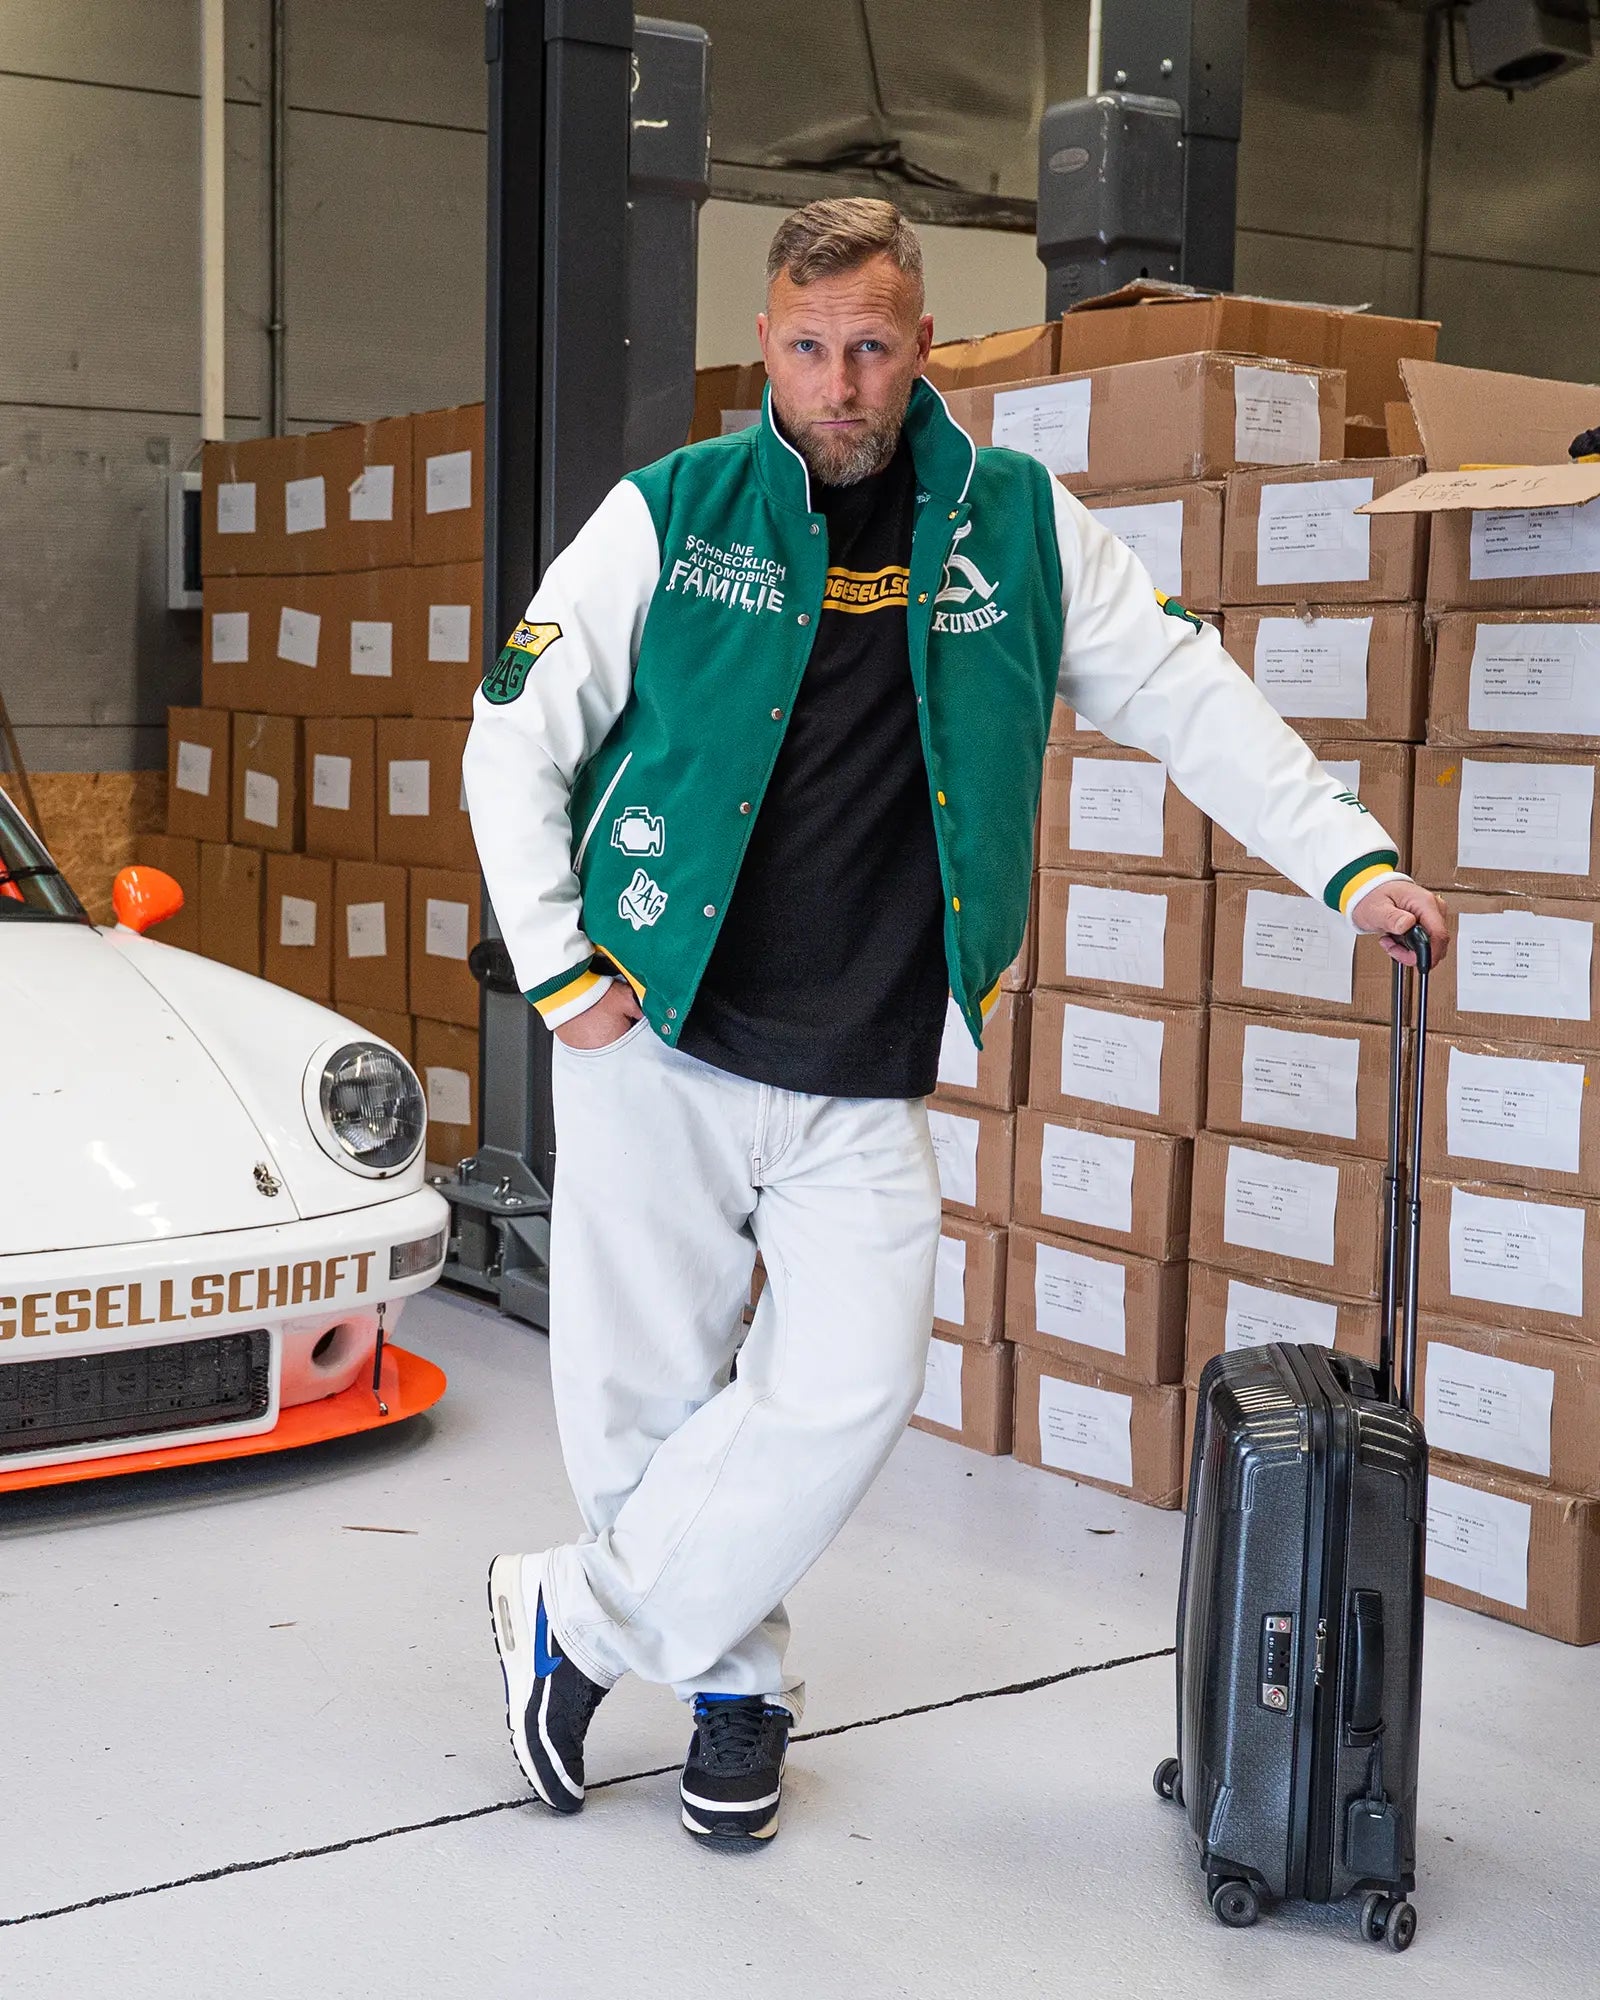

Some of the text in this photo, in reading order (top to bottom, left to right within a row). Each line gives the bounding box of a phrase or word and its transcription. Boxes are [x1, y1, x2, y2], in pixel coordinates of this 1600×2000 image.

[685, 535, 786, 581] SCHRECKLICH
[730, 542, 754, 556] INE
[665, 559, 785, 615] FAMILIE
[689, 552, 777, 587] AUTOMOBILE
[931, 601, 1009, 633] KUNDE
